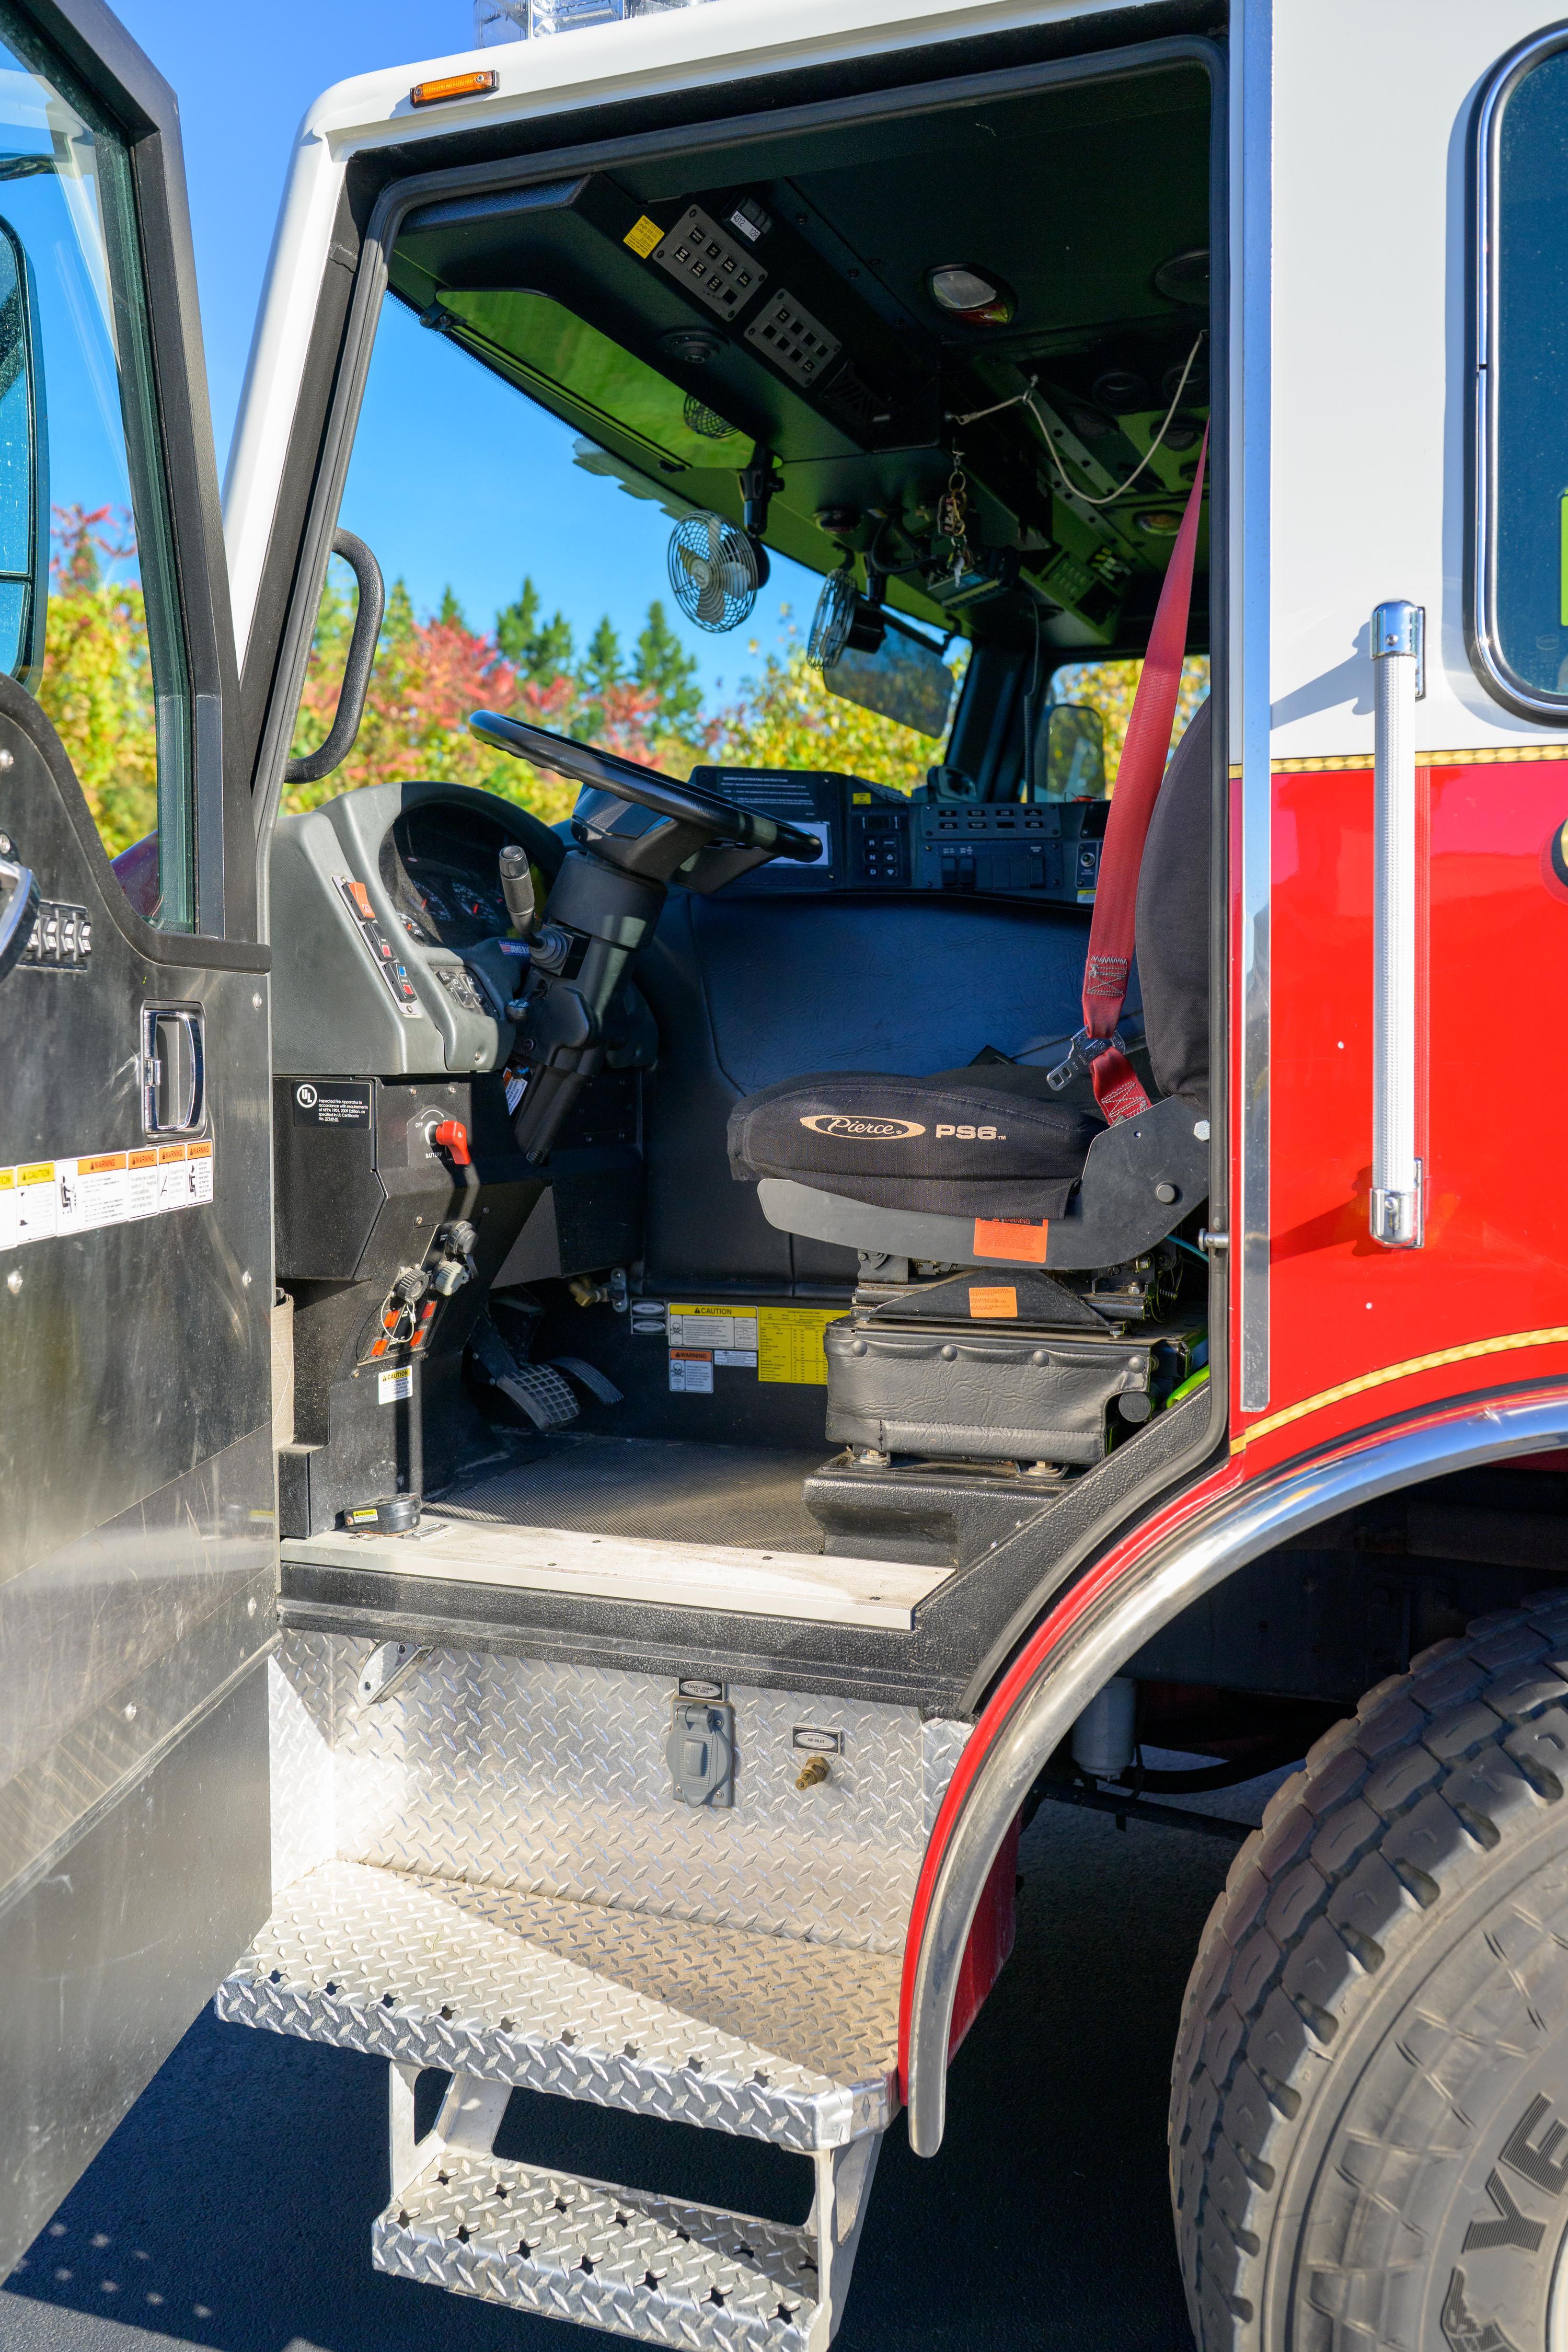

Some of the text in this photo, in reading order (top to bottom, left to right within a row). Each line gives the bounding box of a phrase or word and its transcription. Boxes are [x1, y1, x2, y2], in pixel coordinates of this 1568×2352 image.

[733, 213, 760, 240] 4312 12R
[302, 1089, 313, 1103] UL
[827, 1117, 895, 1134] Pierce
[165, 1149, 182, 1159] WARNING
[193, 1146, 209, 1155] WARNING
[95, 1159, 115, 1169] WARNING
[135, 1155, 154, 1163] WARNING
[29, 1169, 50, 1179] CAUTION
[387, 1370, 408, 1379] CAUTION
